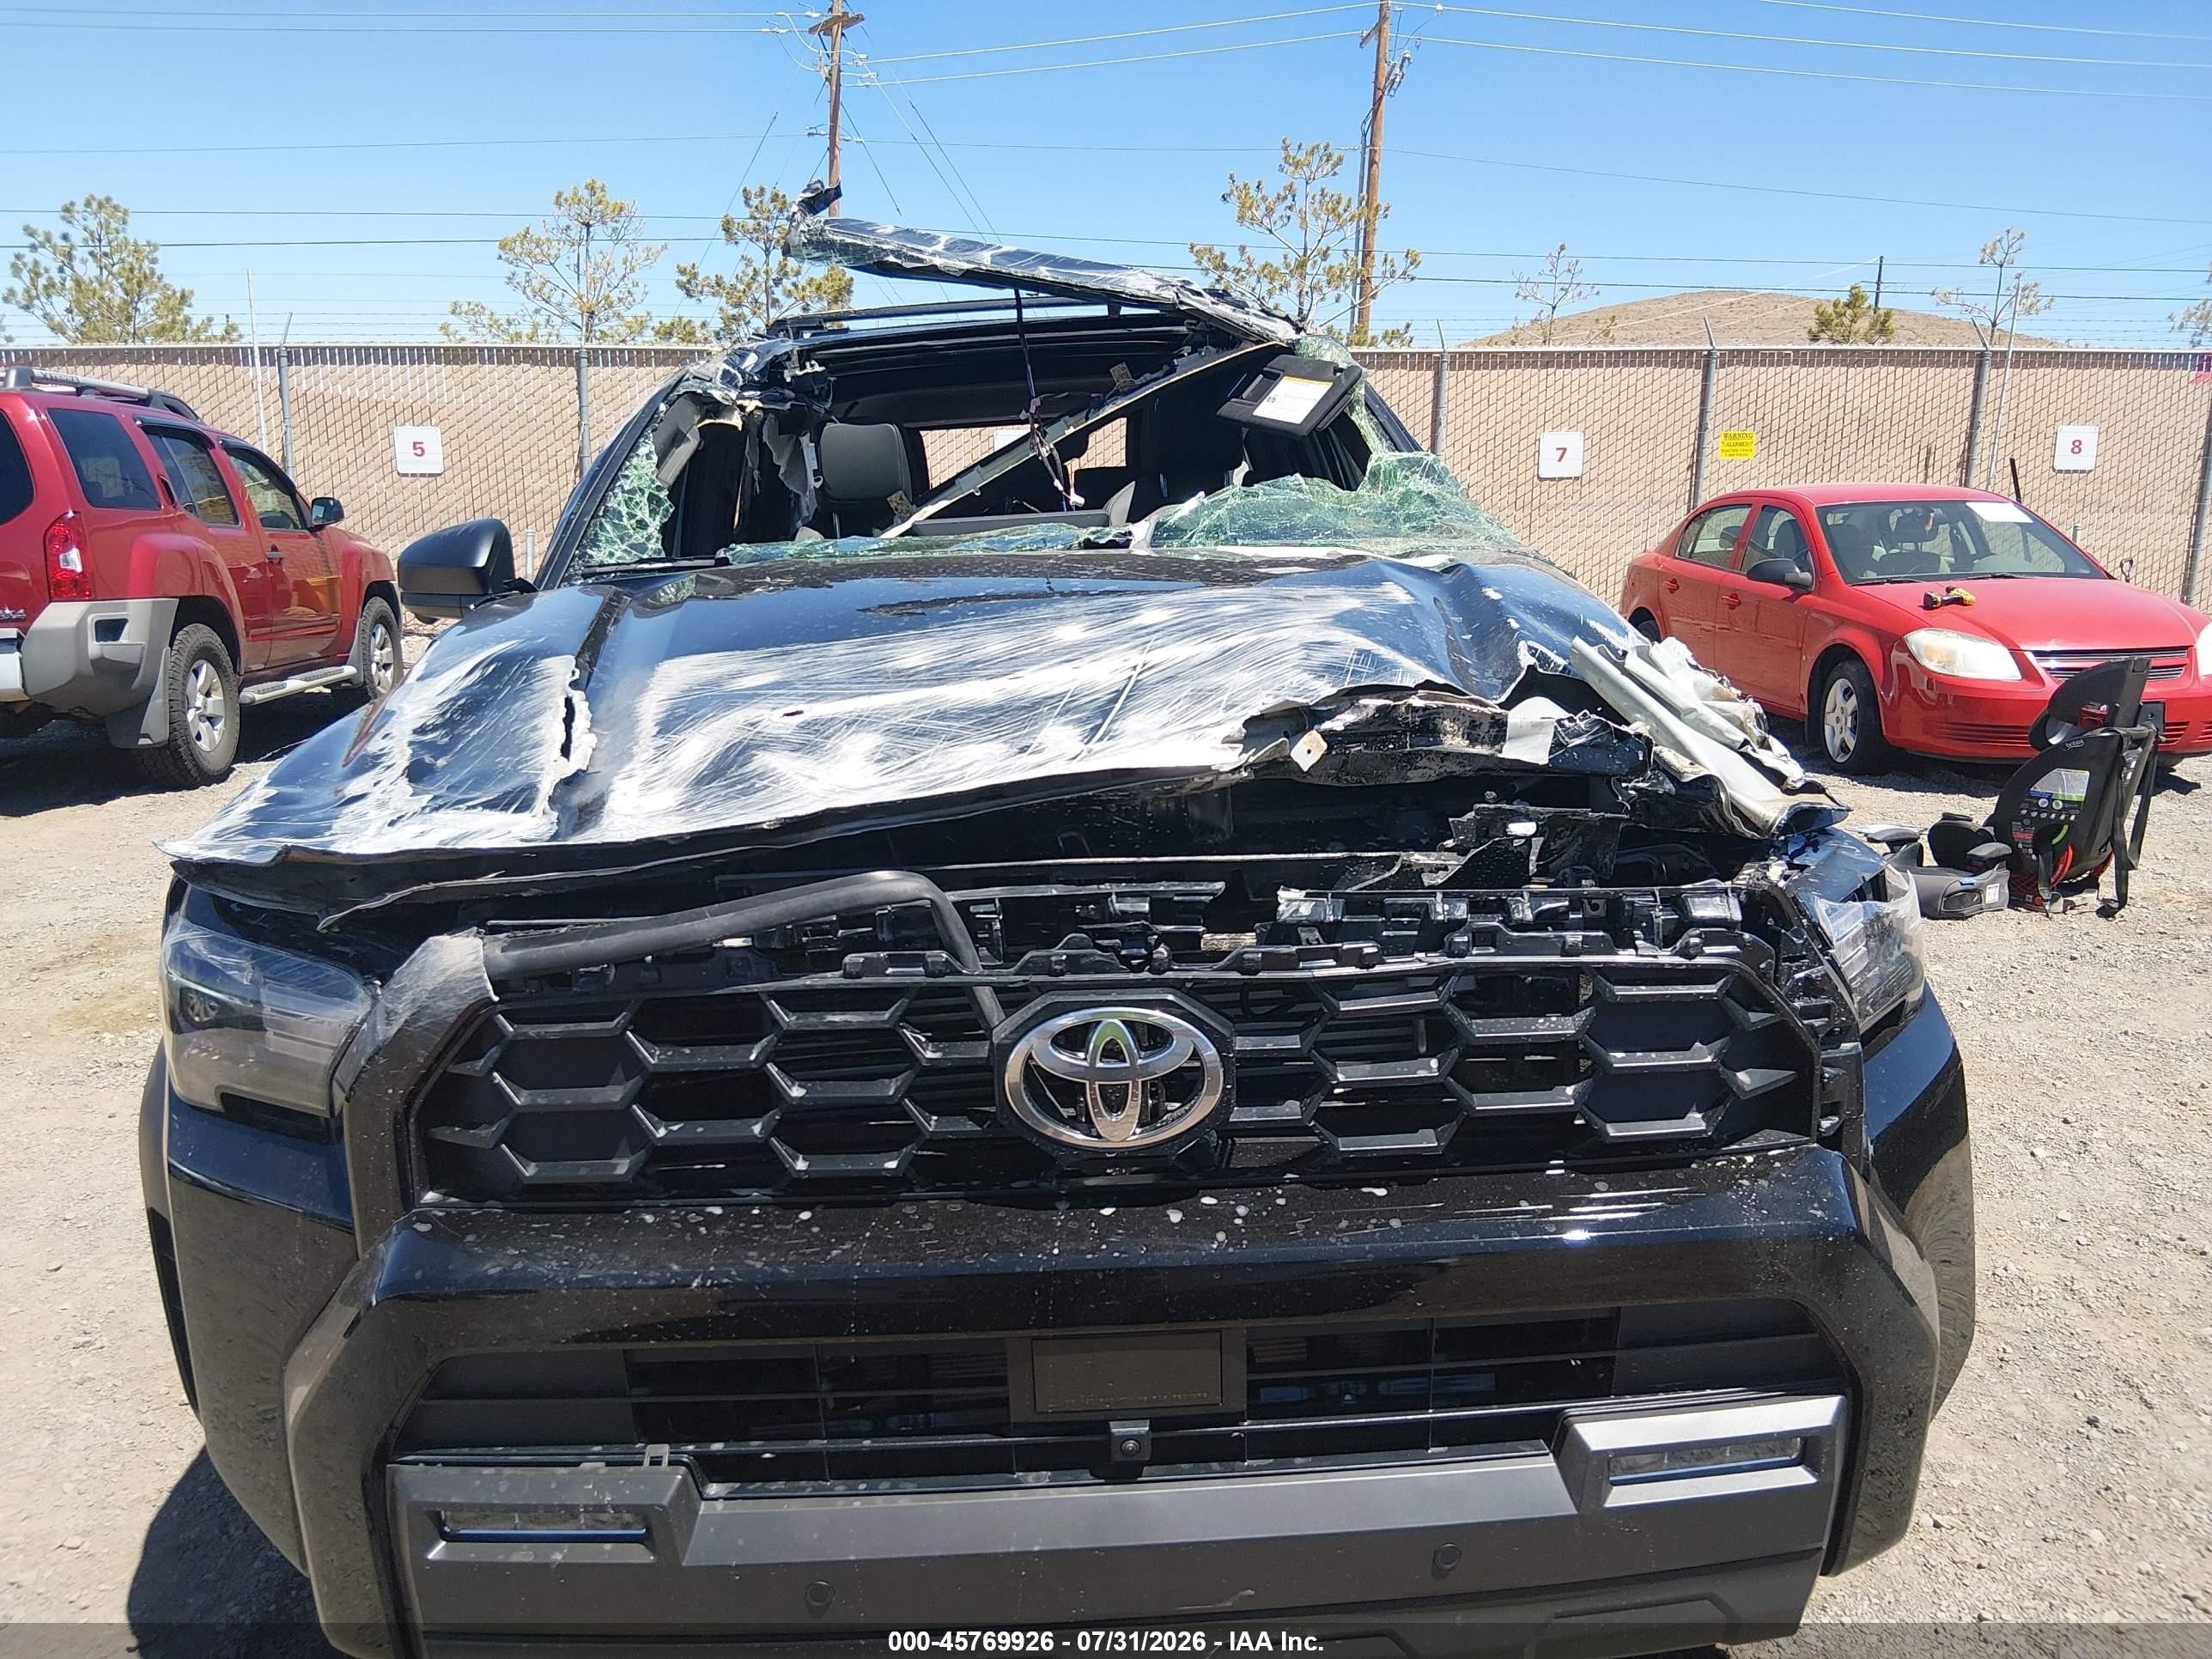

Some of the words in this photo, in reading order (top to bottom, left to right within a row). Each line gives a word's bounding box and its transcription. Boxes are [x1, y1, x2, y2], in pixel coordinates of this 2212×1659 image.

[412, 441, 425, 457] 5
[2070, 439, 2082, 454] 8
[1555, 447, 1567, 463] 7
